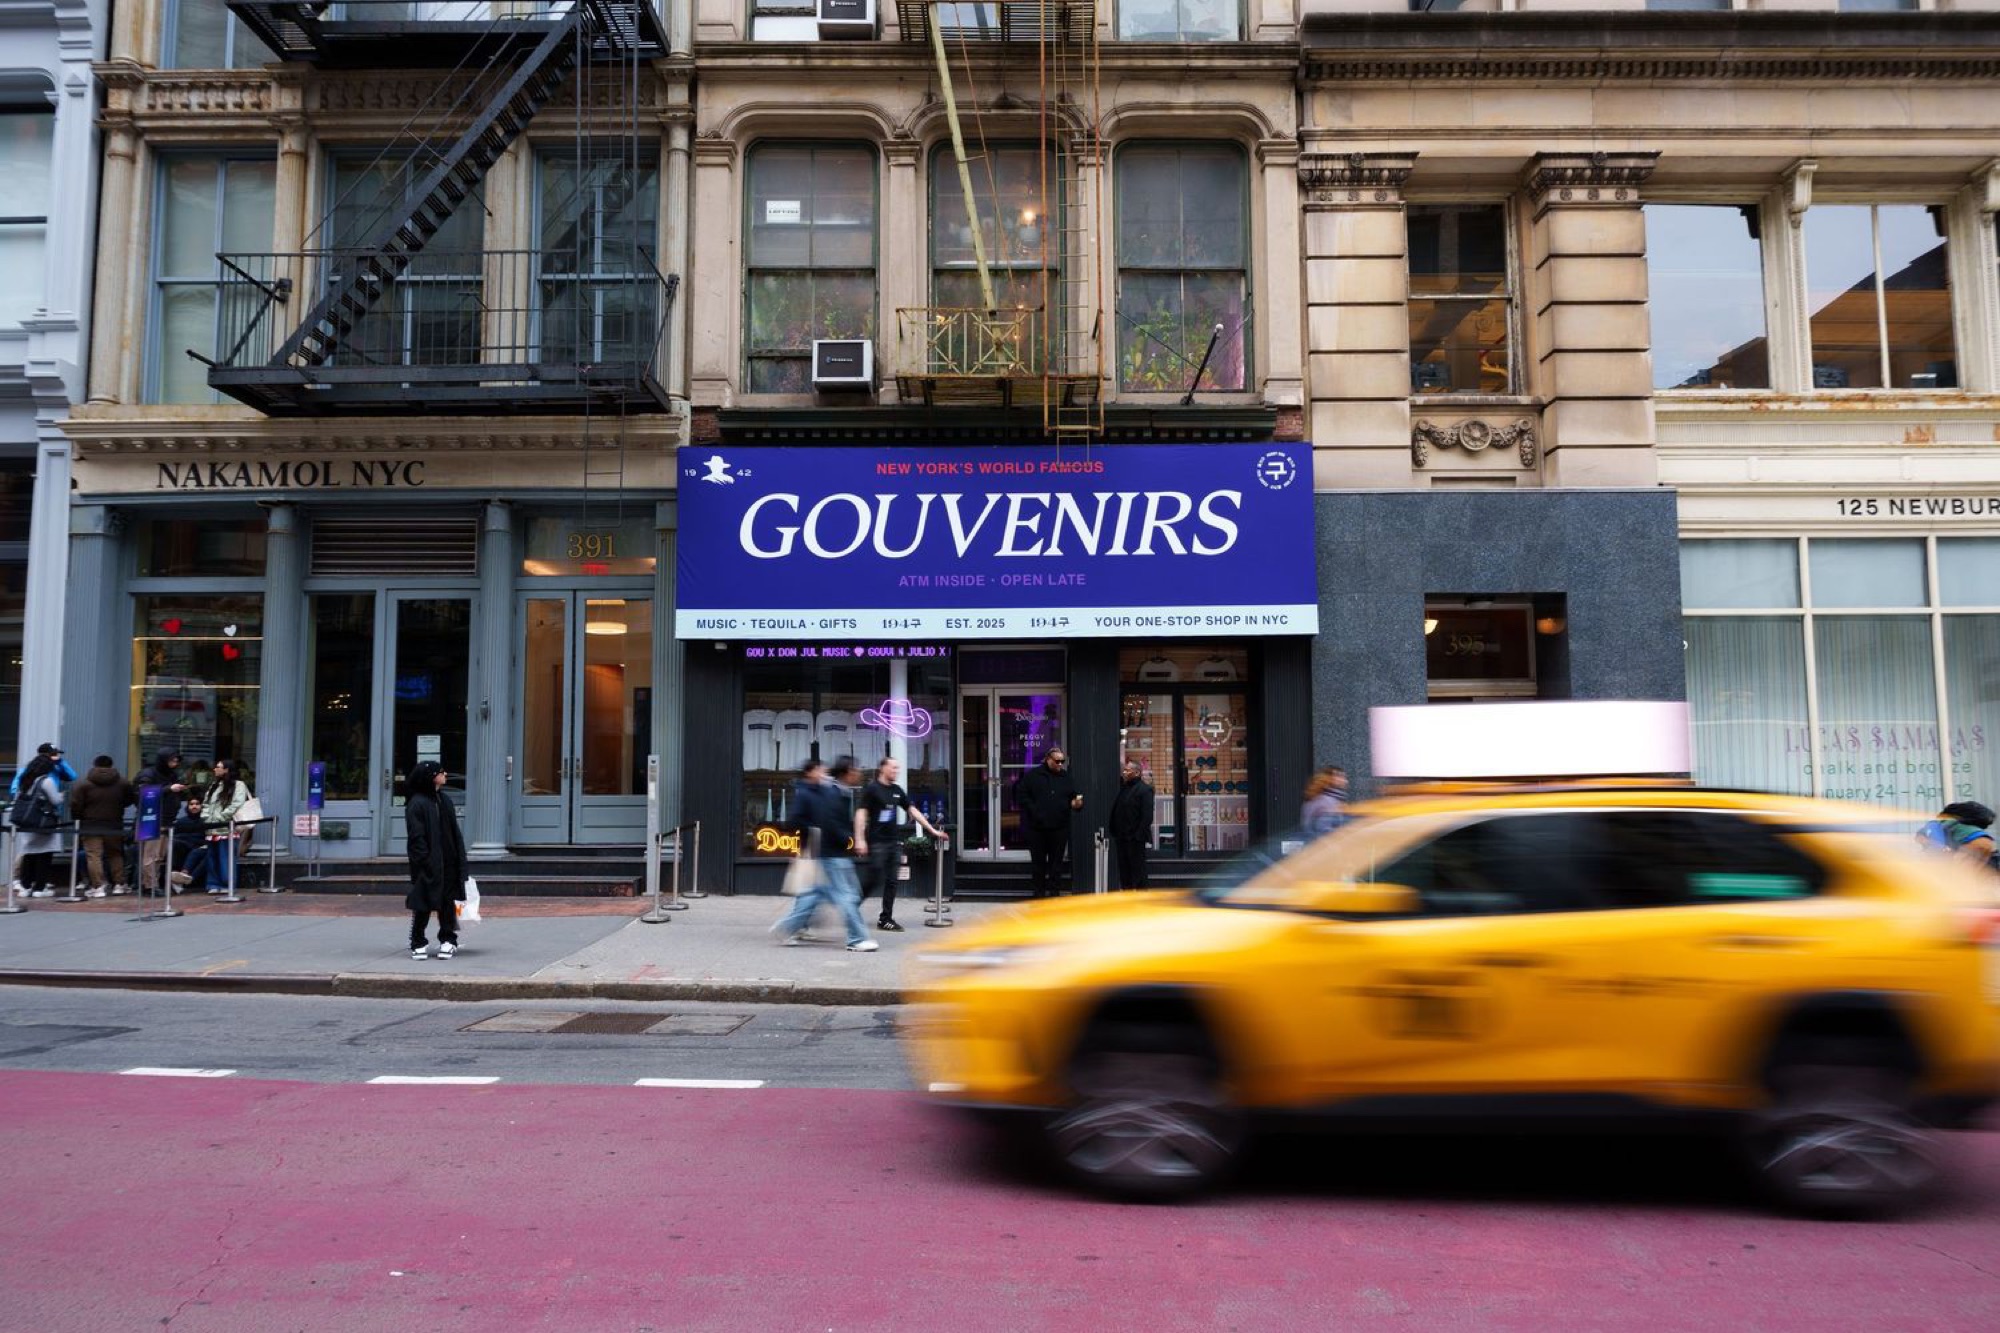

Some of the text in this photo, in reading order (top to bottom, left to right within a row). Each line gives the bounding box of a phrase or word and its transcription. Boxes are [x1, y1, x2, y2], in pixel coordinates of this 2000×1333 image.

[156, 460, 426, 488] NAKAMOL NYC
[684, 468, 752, 477] 19 42
[876, 461, 1105, 474] NEW YORK'S WORLD FAMOUS
[1836, 498, 1879, 516] 125
[738, 489, 1242, 560] GOUVENIRS
[567, 533, 617, 558] 391
[898, 573, 1087, 587] ATM INSIDE OPEN LATE
[696, 619, 738, 630] MUSIC
[750, 618, 807, 630] TEQUILA
[818, 618, 858, 629] GIFTS
[945, 618, 973, 629] EST.
[976, 618, 1006, 629] 2025
[1094, 616, 1131, 627] YOUR
[1135, 615, 1202, 627] ONE-STOP
[1205, 615, 1242, 626] SHOP
[1245, 615, 1259, 625] IN
[1262, 614, 1289, 625] NYC
[746, 647, 765, 658] GOU
[768, 647, 775, 657] X
[778, 647, 797, 657] DON
[822, 647, 851, 657] MUSIC
[1870, 724, 1985, 757] SAMAAS
[1803, 759, 1972, 775] calk and broze
[1875, 784, 1896, 798] 24
